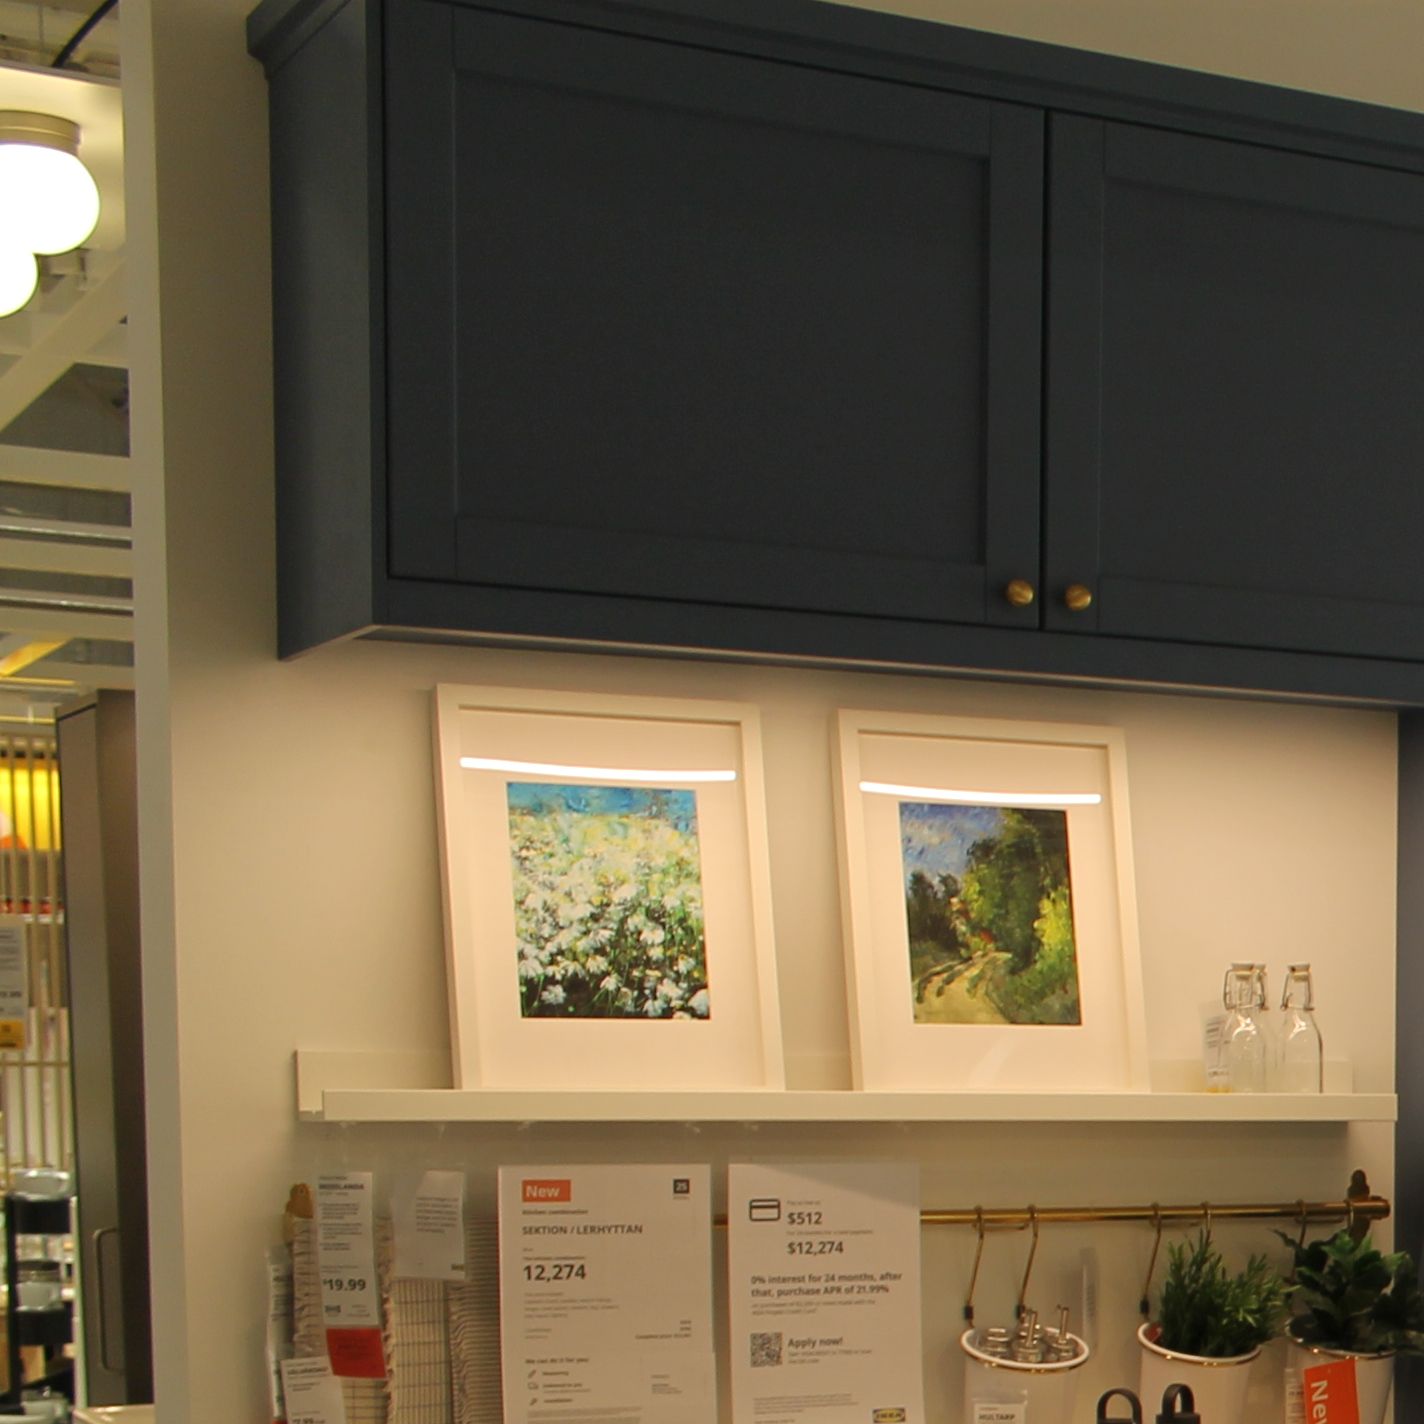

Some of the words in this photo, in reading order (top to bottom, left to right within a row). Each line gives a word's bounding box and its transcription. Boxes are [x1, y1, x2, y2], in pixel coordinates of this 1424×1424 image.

[526, 1185, 560, 1198] New
[787, 1212, 822, 1225] $512
[522, 1225, 567, 1236] SEKTION
[576, 1224, 643, 1235] LERHYTTAN
[787, 1241, 844, 1256] $12,274
[523, 1264, 587, 1283] 12,274
[768, 1274, 805, 1284] interest
[808, 1273, 822, 1283] for
[824, 1274, 835, 1282] 24
[879, 1272, 903, 1281] after
[777, 1286, 821, 1298] purchase
[823, 1286, 842, 1295] APR
[844, 1285, 855, 1294] of
[788, 1338, 817, 1348] Apply
[819, 1336, 843, 1346] now!
